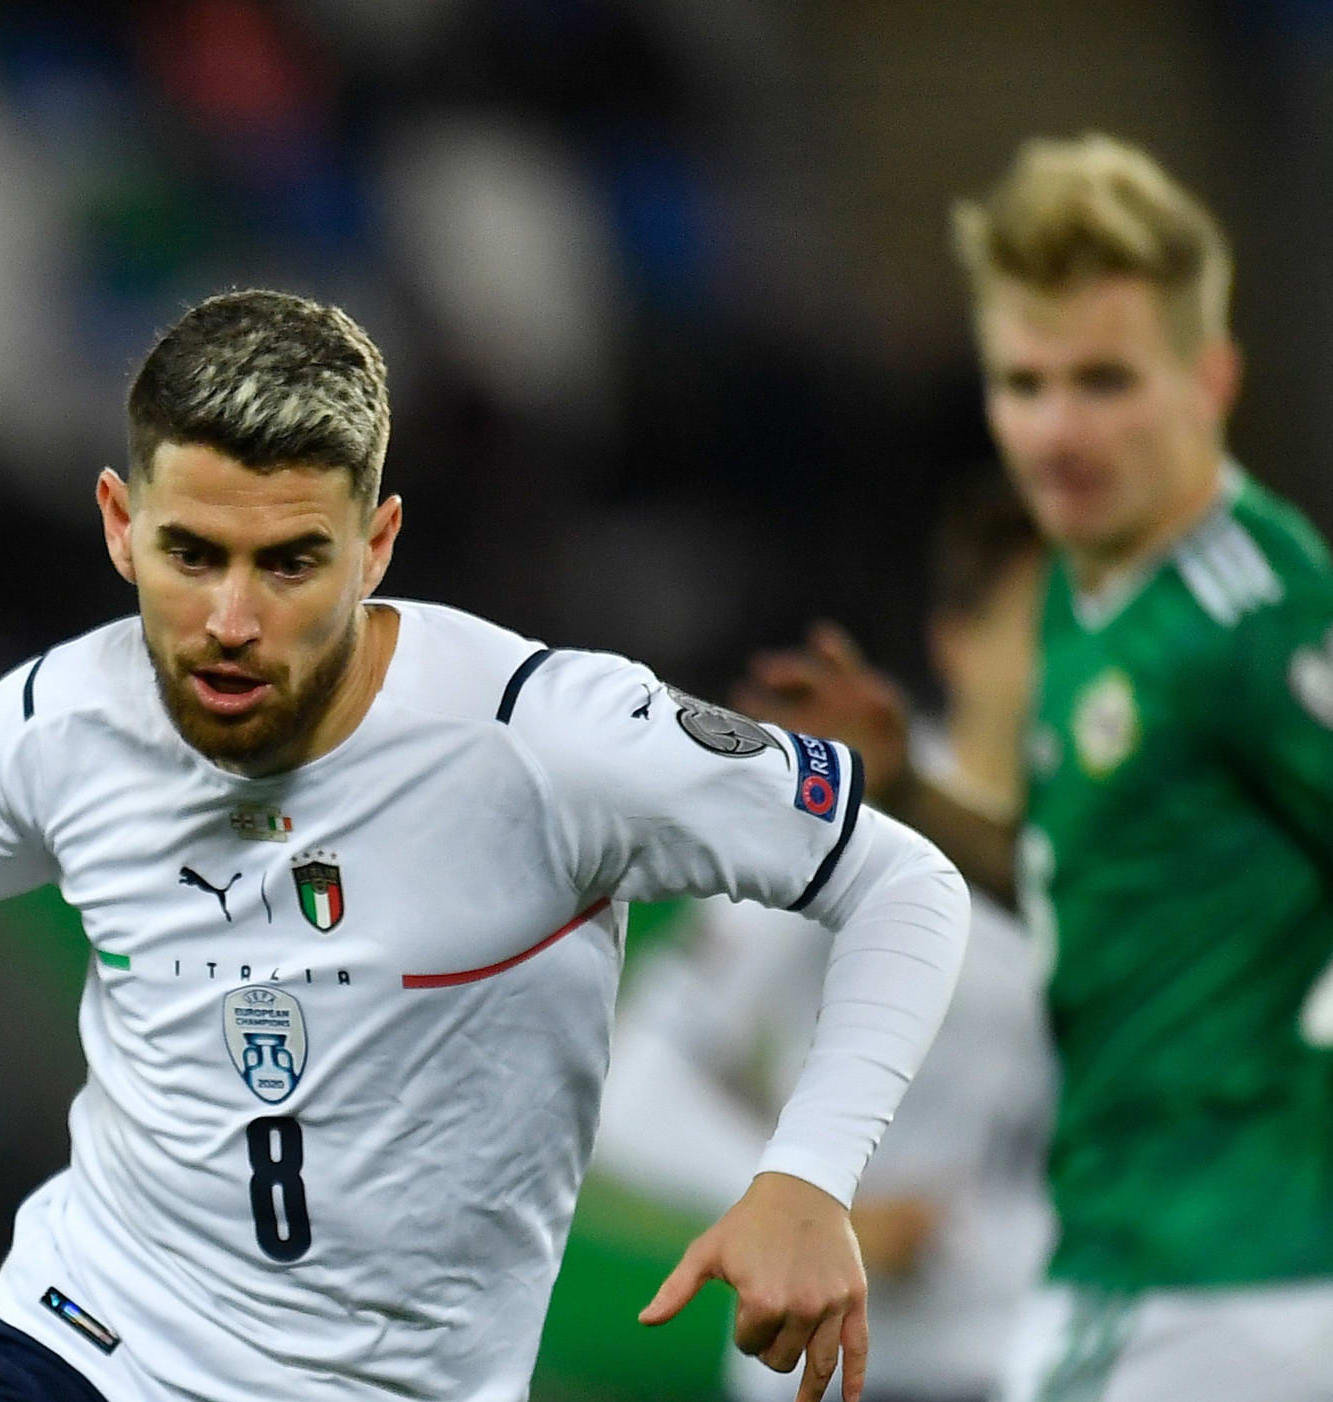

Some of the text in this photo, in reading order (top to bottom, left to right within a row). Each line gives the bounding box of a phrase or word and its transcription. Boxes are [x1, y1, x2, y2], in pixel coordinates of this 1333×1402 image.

[802, 737, 830, 775] RES
[175, 959, 351, 986] ITALIA
[246, 1115, 312, 1263] 8
